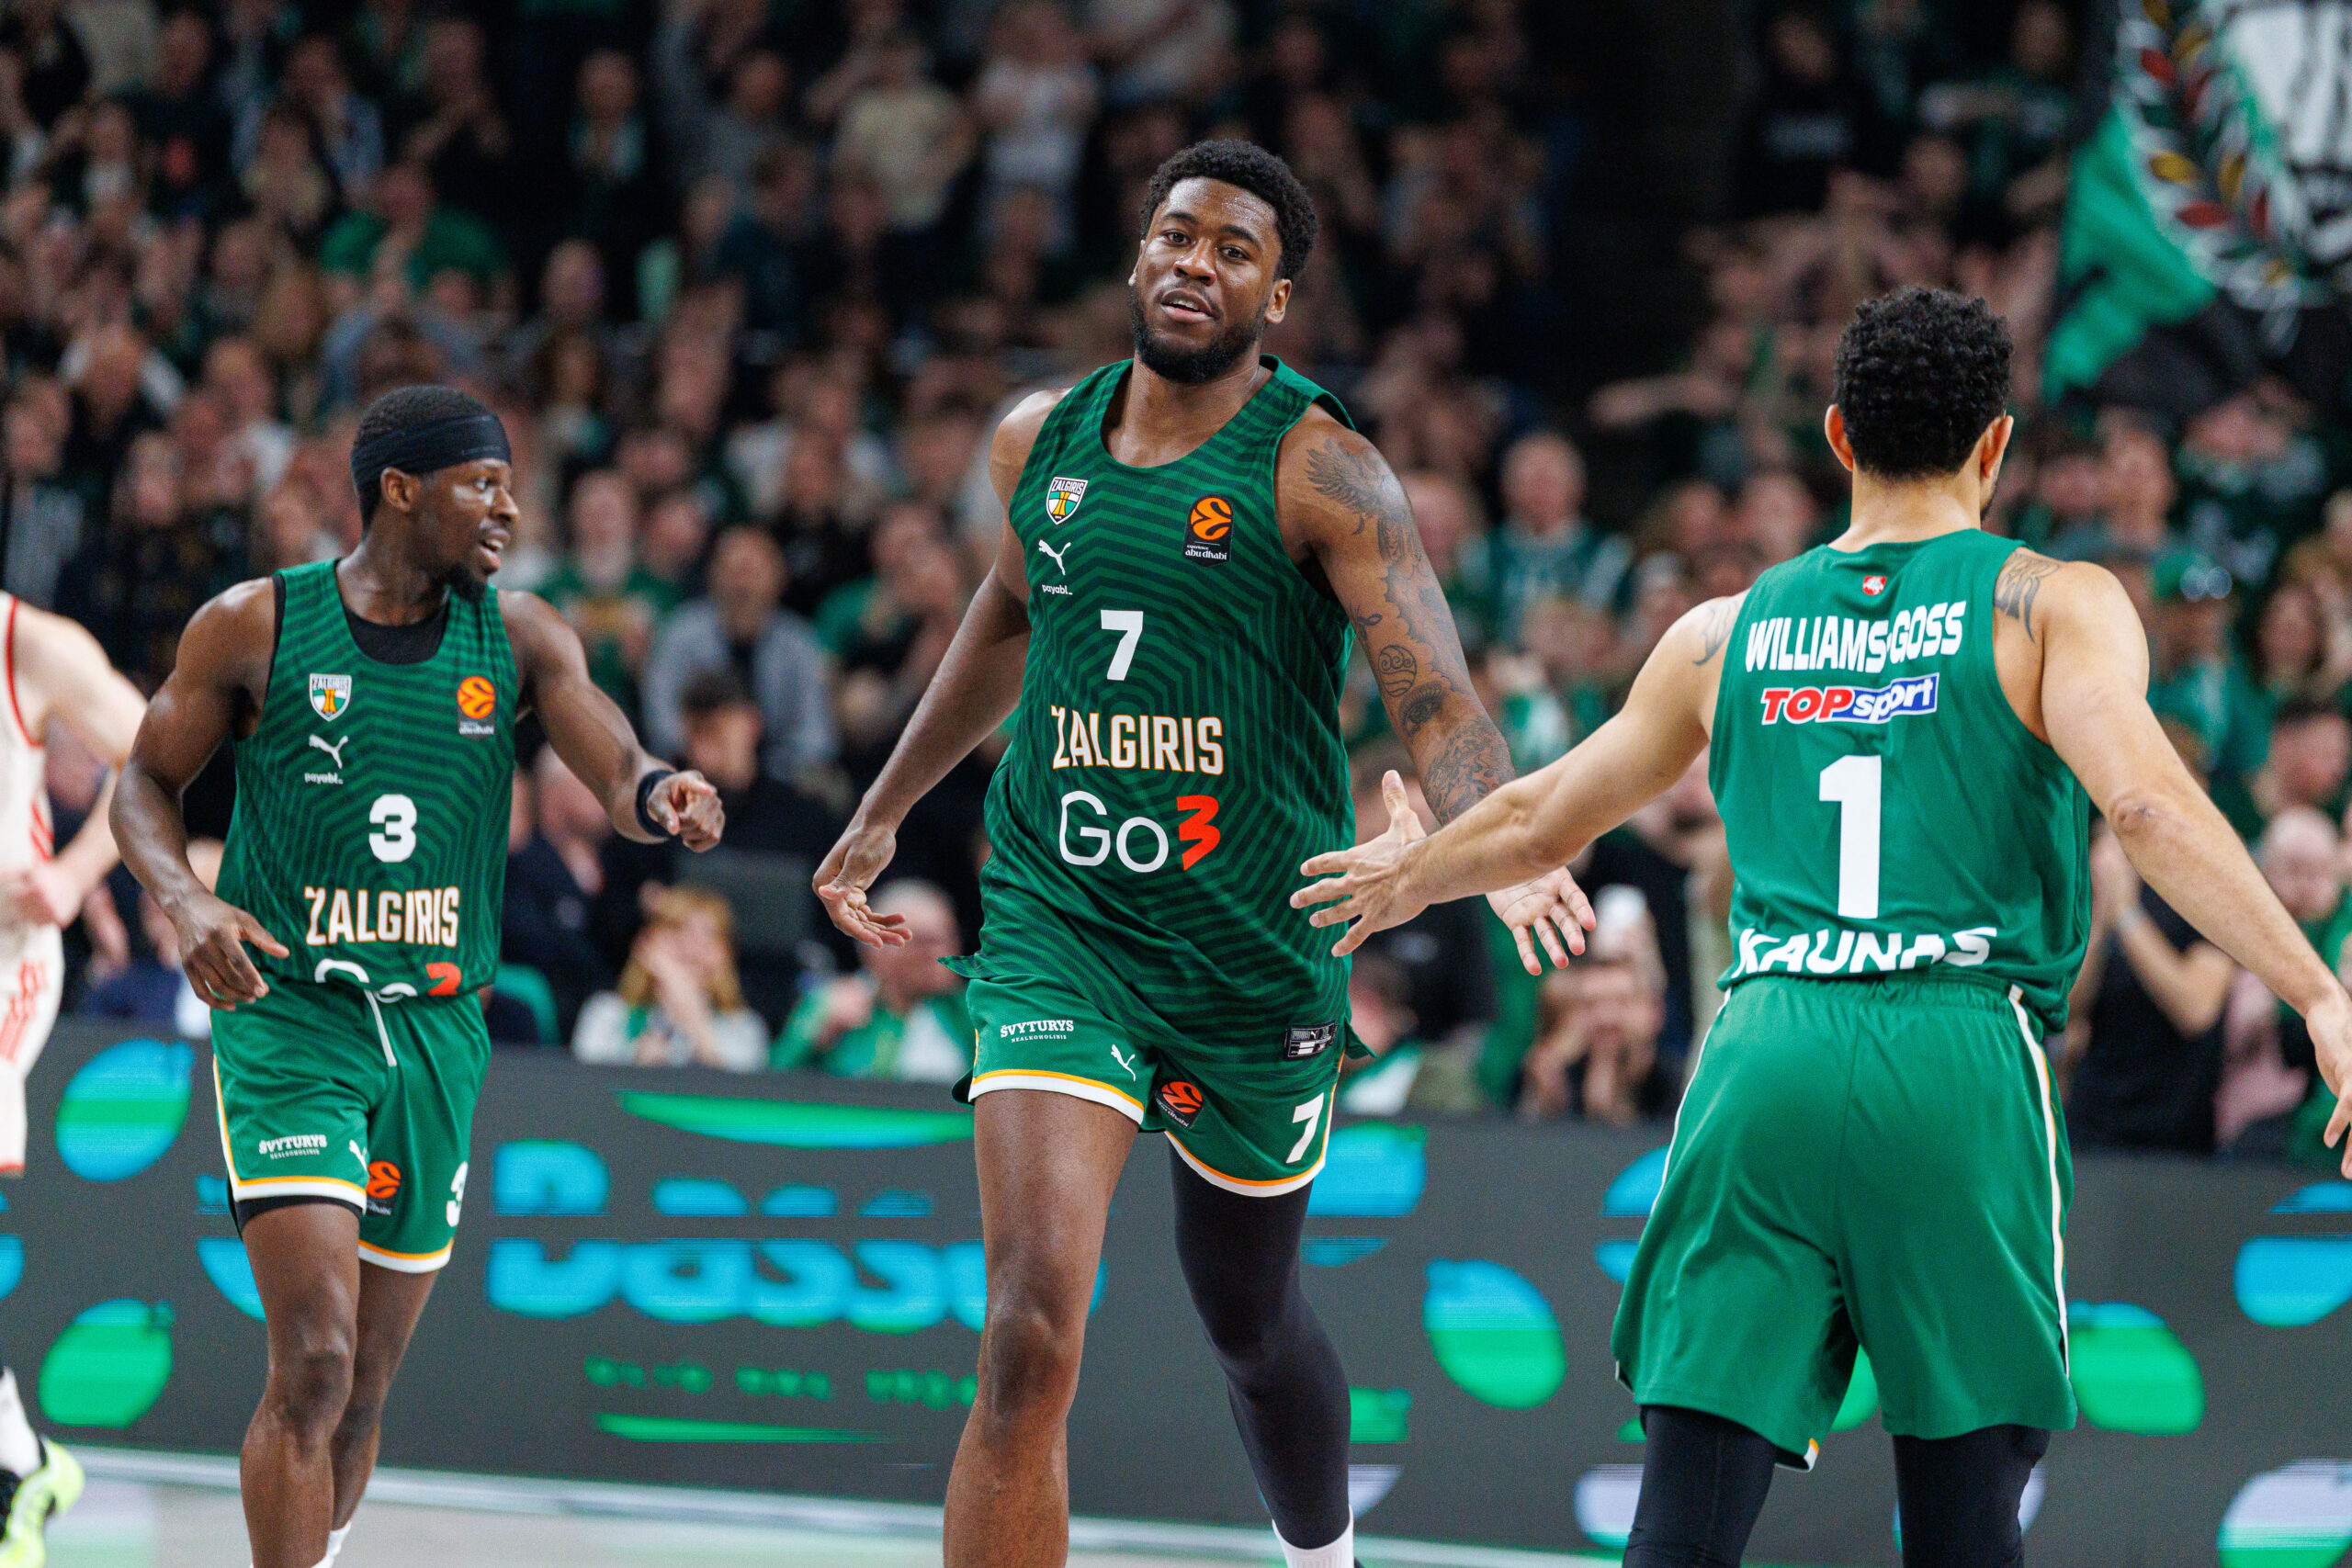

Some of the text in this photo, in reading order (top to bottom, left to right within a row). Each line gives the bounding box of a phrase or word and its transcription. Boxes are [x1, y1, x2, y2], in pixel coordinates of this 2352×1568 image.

[1184, 548, 1227, 560] abu dhabi
[1100, 609, 1144, 681] 7
[1761, 675, 1936, 724] TOPsport
[369, 793, 417, 863] 3
[1058, 790, 1221, 873] Go3
[1819, 754, 1882, 919] 1
[1731, 926, 1997, 978] KAUNAS
[1000, 1020, 1075, 1039] ŠVYTURYS
[1286, 1092, 1325, 1164] 7
